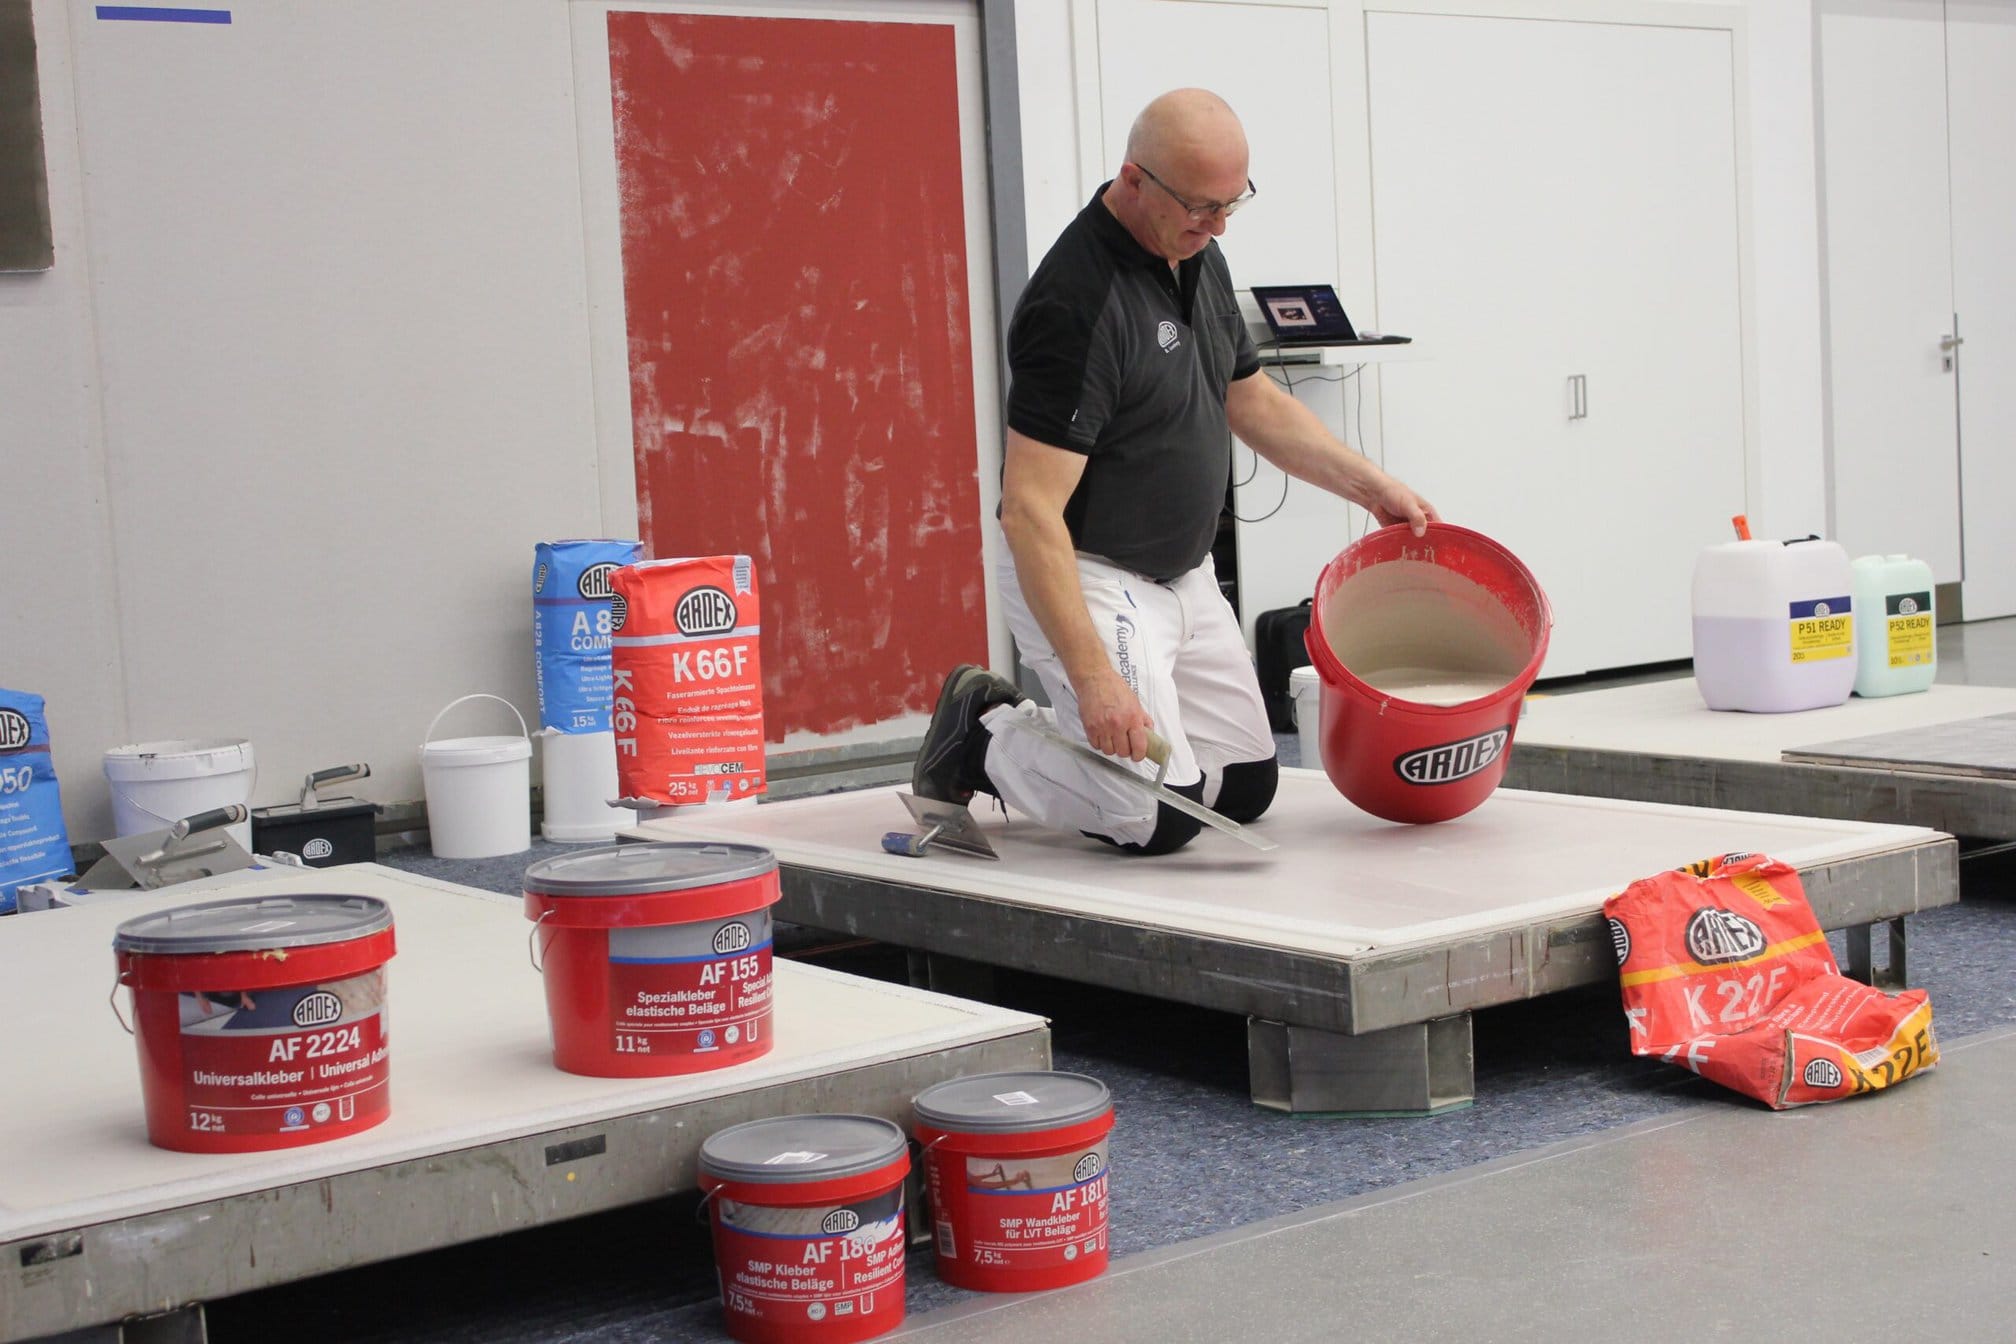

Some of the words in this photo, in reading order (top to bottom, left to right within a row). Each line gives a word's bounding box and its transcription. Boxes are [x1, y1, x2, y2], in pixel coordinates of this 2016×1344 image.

[678, 591, 733, 630] ARDEX
[571, 610, 591, 636] A
[1798, 623, 1805, 634] P
[1806, 622, 1816, 634] 51
[1819, 619, 1846, 632] READY
[1889, 621, 1895, 631] P
[1896, 620, 1905, 630] 52
[1906, 617, 1929, 630] READY
[672, 652, 696, 683] K
[696, 648, 732, 680] 66
[733, 645, 748, 676] F
[613, 669, 634, 692] K
[573, 716, 587, 728] 15
[615, 697, 636, 733] 66
[617, 738, 637, 757] F
[1405, 734, 1506, 781] ARDEX
[669, 781, 687, 796] 25
[715, 923, 750, 952] ARDEX
[1692, 912, 1760, 956] ARDEX
[700, 961, 727, 986] AF
[730, 955, 758, 982] 155
[637, 989, 716, 1004] Spezialkleber
[1684, 983, 1713, 1029] K
[295, 995, 339, 1024] ARDEX
[626, 1005, 685, 1017] elastische
[689, 1002, 726, 1016] Beläge
[268, 1037, 302, 1063] AF
[306, 1026, 361, 1058] 2224
[615, 1035, 636, 1053] 11
[319, 1054, 371, 1078] Universal
[1806, 1060, 1841, 1085] ARDEX
[193, 1069, 304, 1087] Universalkleber
[190, 1112, 210, 1131] 12
[1052, 1190, 1076, 1213] AF
[1080, 1180, 1102, 1207] 181
[824, 1211, 860, 1233] ARDEX
[1000, 1217, 1023, 1228] SMP
[1026, 1212, 1080, 1228] Wandkleber
[1005, 1228, 1020, 1239] für
[1023, 1227, 1041, 1239] LVT
[1045, 1223, 1076, 1237] Beläge
[803, 1241, 833, 1264] AF
[866, 1250, 886, 1267] SMP
[973, 1249, 993, 1265] 7,5
[748, 1260, 772, 1274] SMP
[775, 1264, 816, 1277] Kleber
[854, 1262, 892, 1284] Resilient
[736, 1271, 787, 1289] elastische
[791, 1278, 834, 1292] Beläge
[727, 1291, 745, 1311] 7,5
[834, 1301, 852, 1312] SMP
